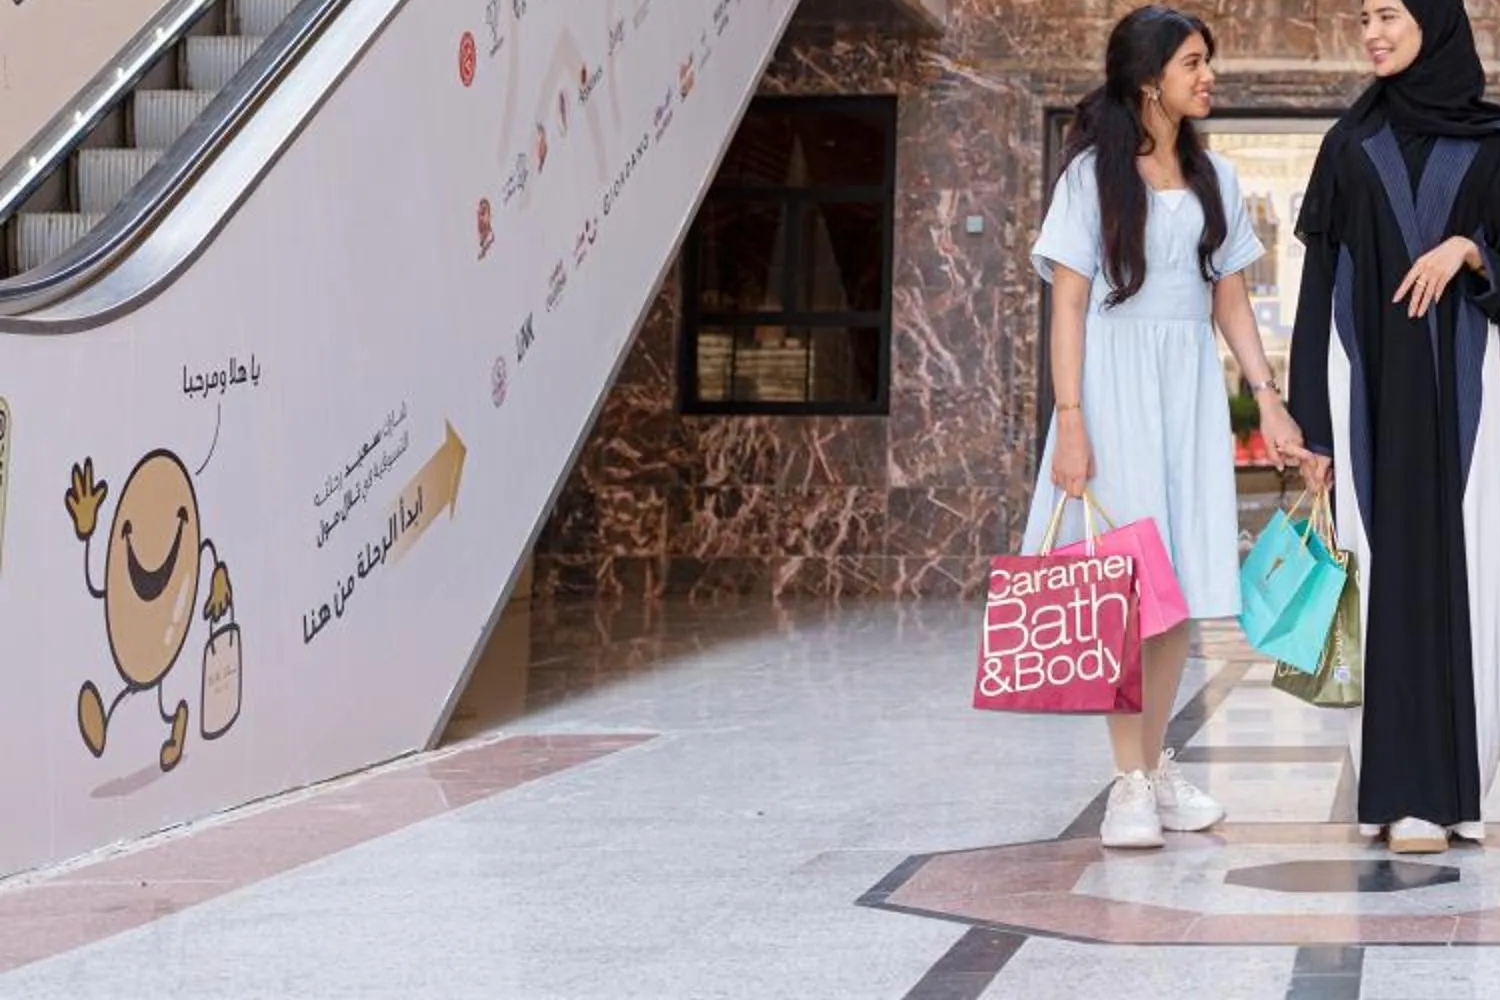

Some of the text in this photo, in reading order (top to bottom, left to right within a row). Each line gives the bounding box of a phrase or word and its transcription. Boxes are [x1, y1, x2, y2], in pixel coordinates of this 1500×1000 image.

[229, 356, 247, 386] هلا
[251, 352, 261, 387] يا
[302, 485, 424, 645] ابدأ الرحلة من هنا
[984, 583, 1129, 659] Bath
